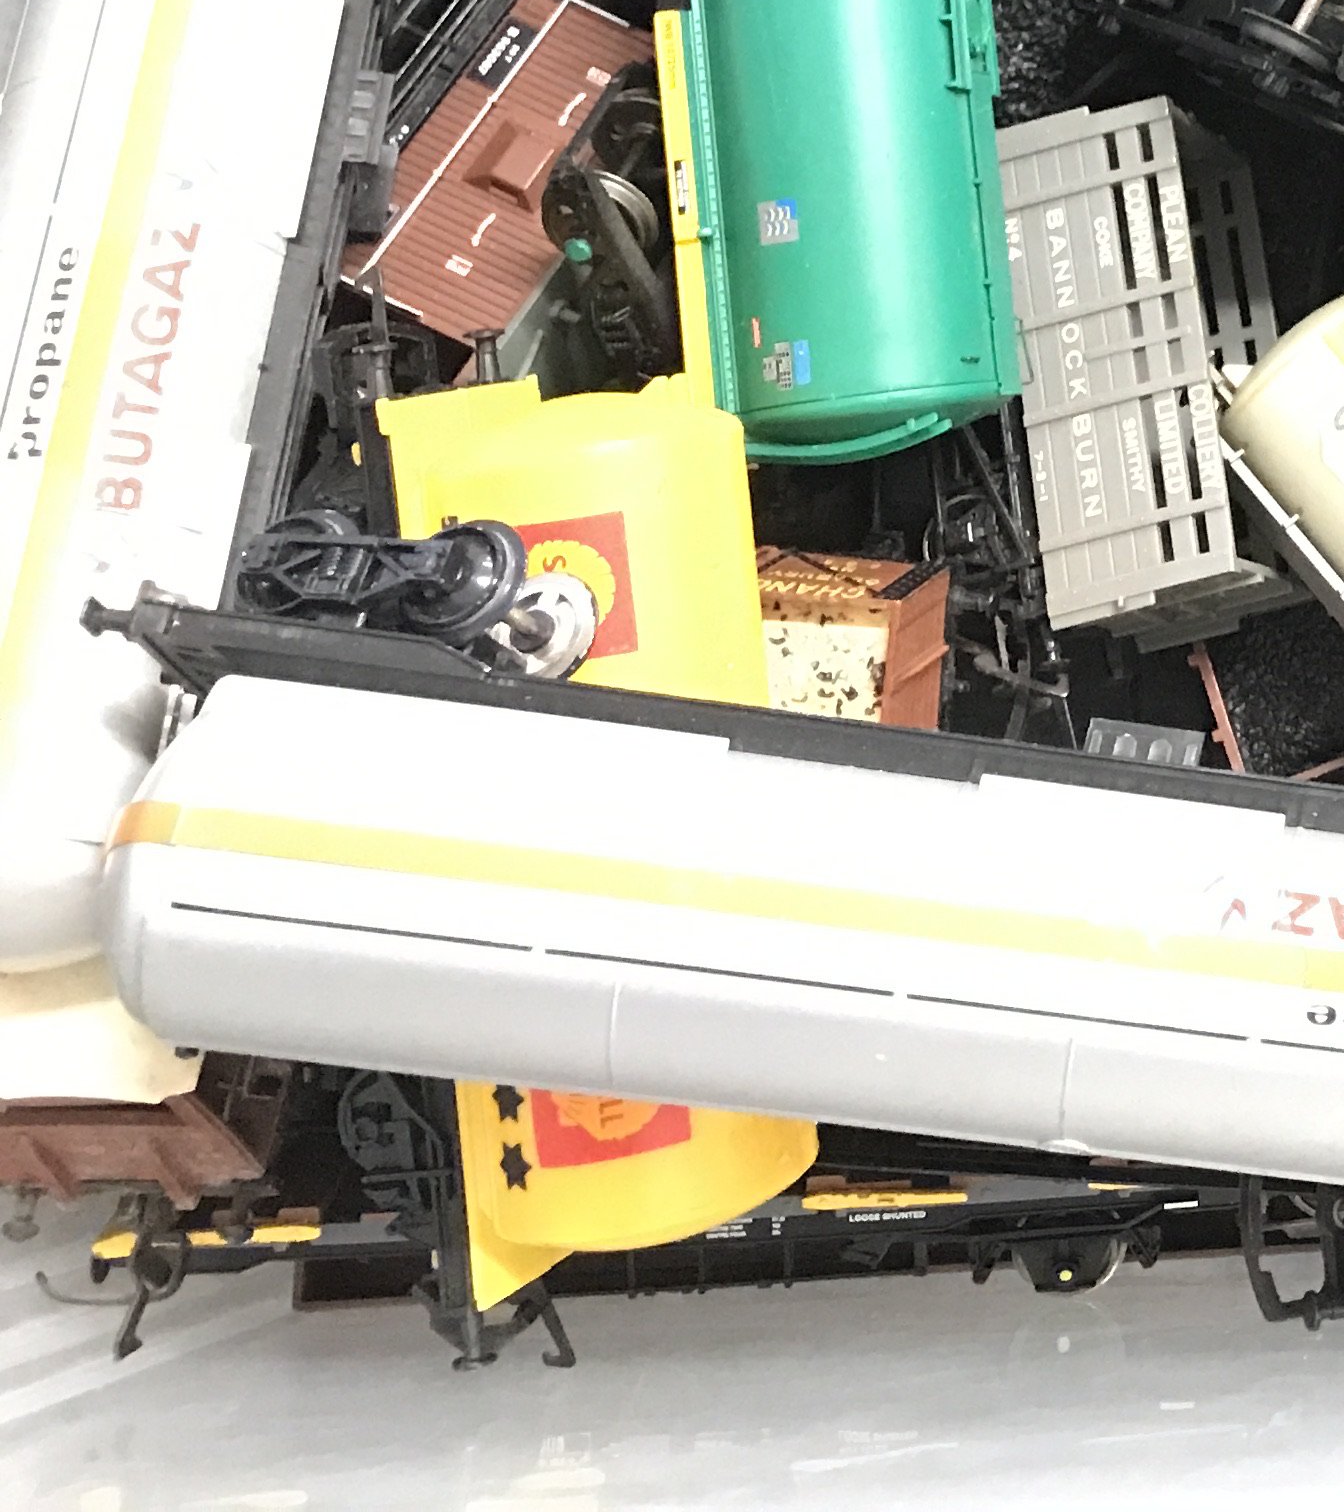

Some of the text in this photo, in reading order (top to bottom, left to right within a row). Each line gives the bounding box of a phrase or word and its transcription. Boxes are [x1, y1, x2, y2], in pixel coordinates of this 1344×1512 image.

[6, 246, 81, 462] propane
[94, 222, 201, 512] BUTAGAZ
[1092, 215, 1147, 494] COKE SMITHY
[1123, 182, 1187, 496] COMPANY LIMITED
[1158, 184, 1225, 490] PLEAN COLLIERY
[848, 1212, 881, 1223] LOOSE
